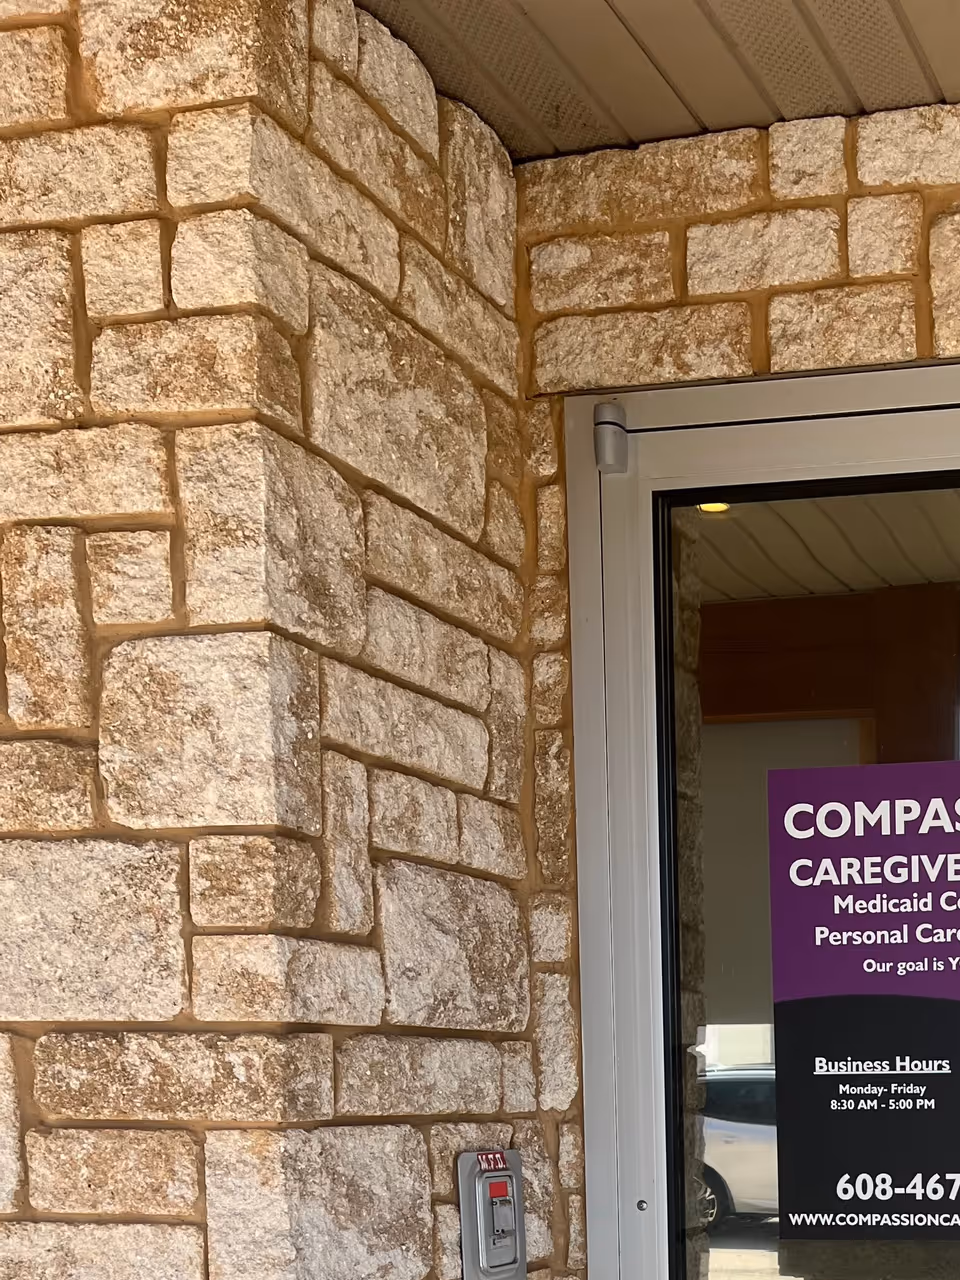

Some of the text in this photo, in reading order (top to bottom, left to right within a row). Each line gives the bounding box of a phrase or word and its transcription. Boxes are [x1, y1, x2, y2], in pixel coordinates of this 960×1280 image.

[833, 892, 933, 914] Medicaid
[815, 924, 909, 946] Personal
[862, 958, 894, 973] Our
[896, 957, 929, 976] goal
[932, 957, 945, 971] is
[814, 1055, 951, 1074] Business Hours
[838, 1083, 927, 1097] Monday- Friday
[830, 1099, 855, 1110] 8:30
[857, 1099, 878, 1110] AM
[888, 1099, 913, 1110] 5:00
[916, 1098, 935, 1110] PM
